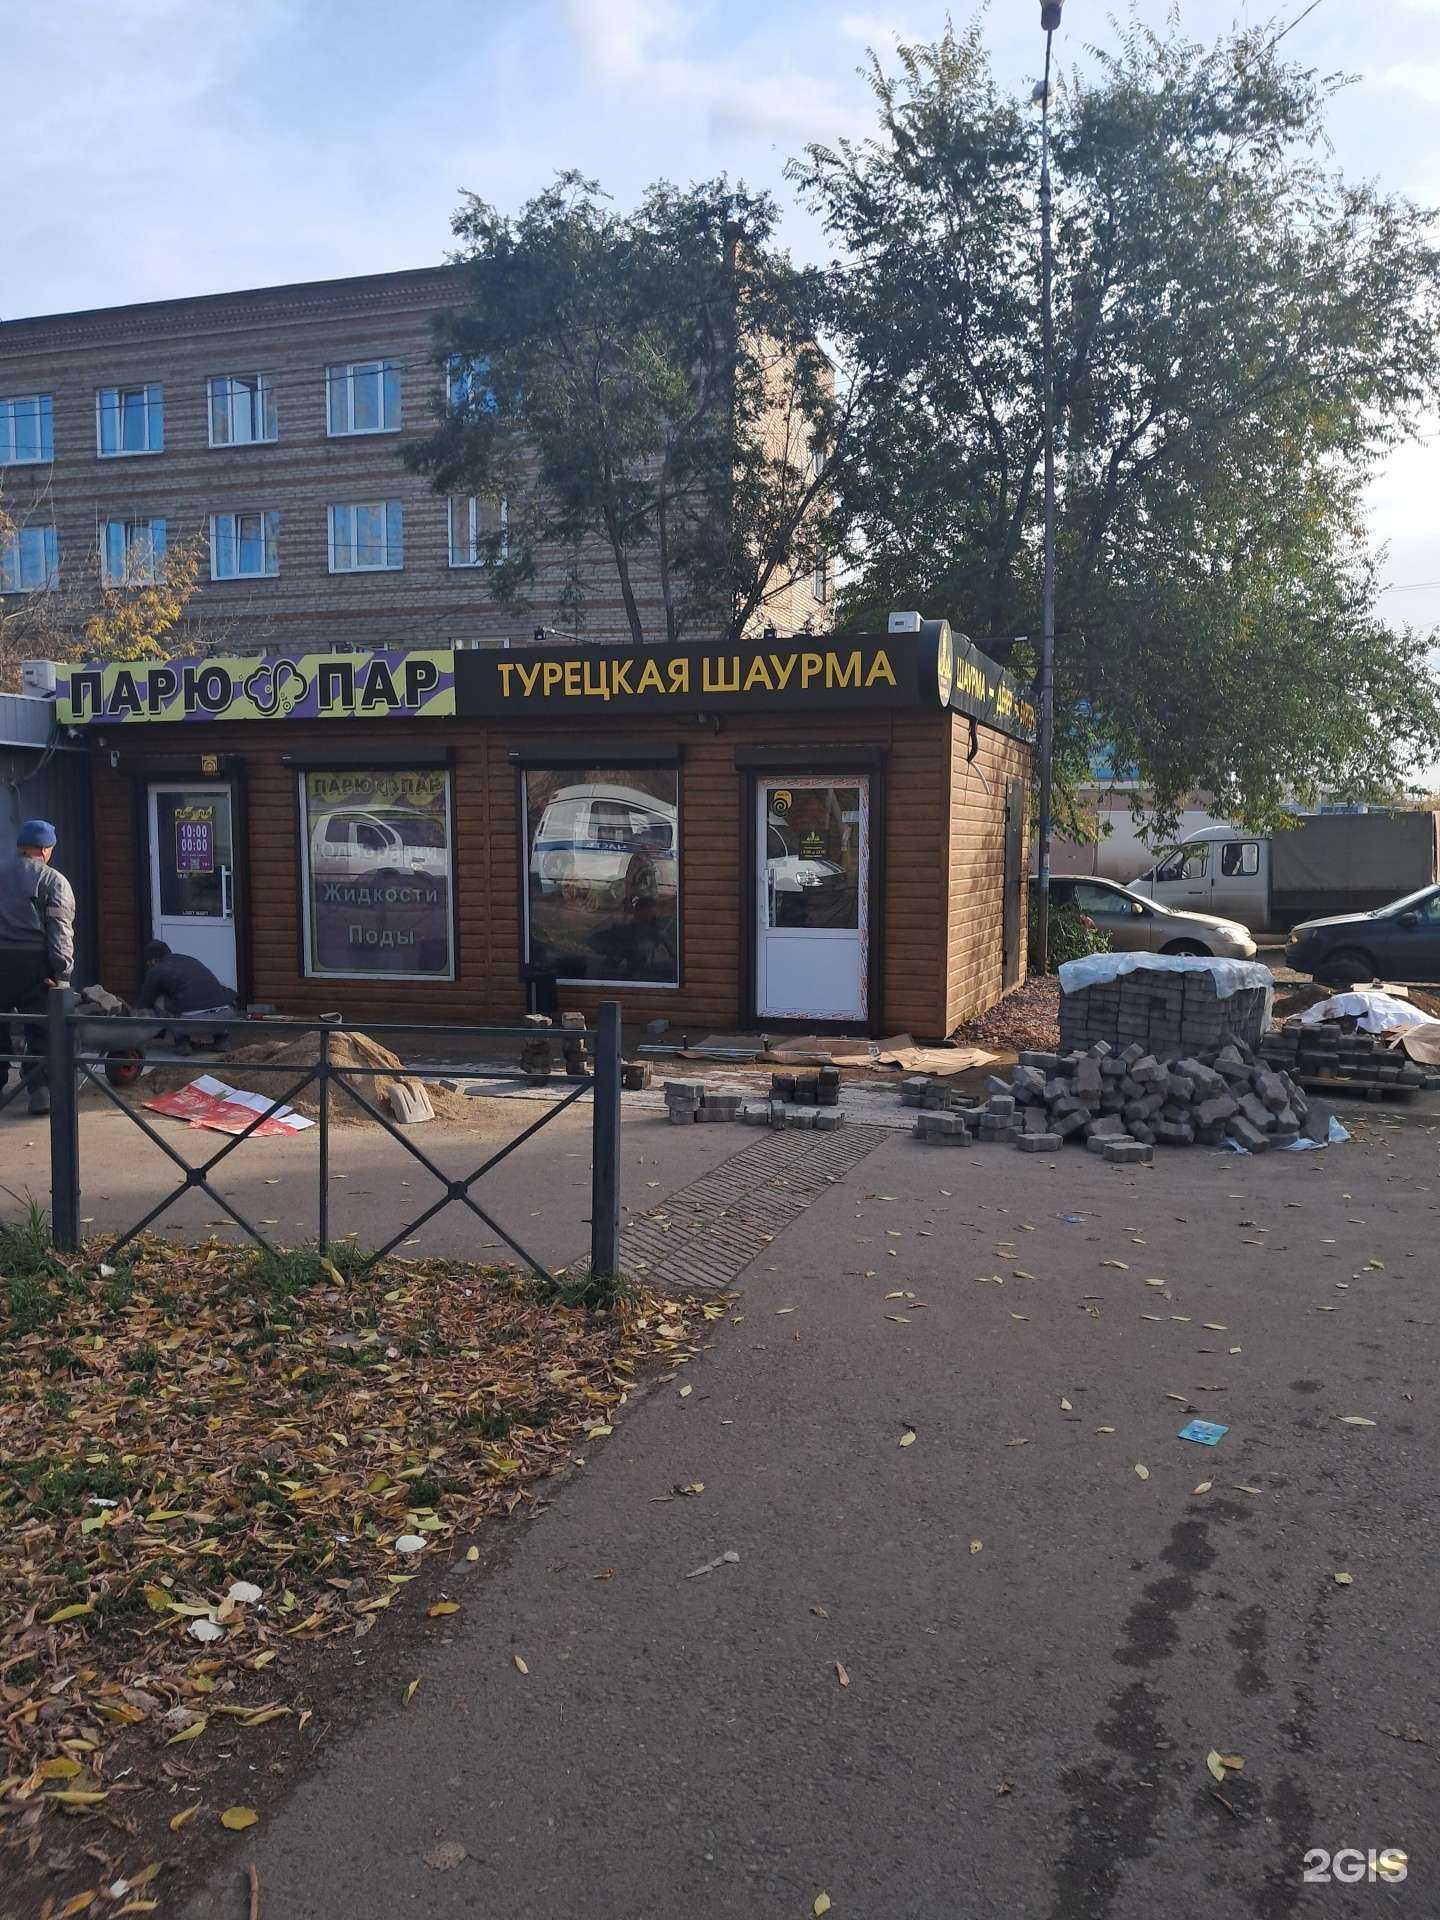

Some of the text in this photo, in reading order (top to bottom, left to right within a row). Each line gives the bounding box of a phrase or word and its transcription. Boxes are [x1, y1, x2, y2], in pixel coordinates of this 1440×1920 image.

[497, 649, 898, 701] ТУРЕЦКАЯ ШАУРМА
[957, 657, 985, 702] ШАУРМА
[70, 659, 440, 718] ПАРЮ ПАР
[315, 776, 443, 795] ПАРЮ ПАР
[180, 825, 208, 838] 10:00
[180, 838, 208, 852] 00:00
[323, 883, 438, 905] Жидкости
[350, 924, 415, 948] Поды
